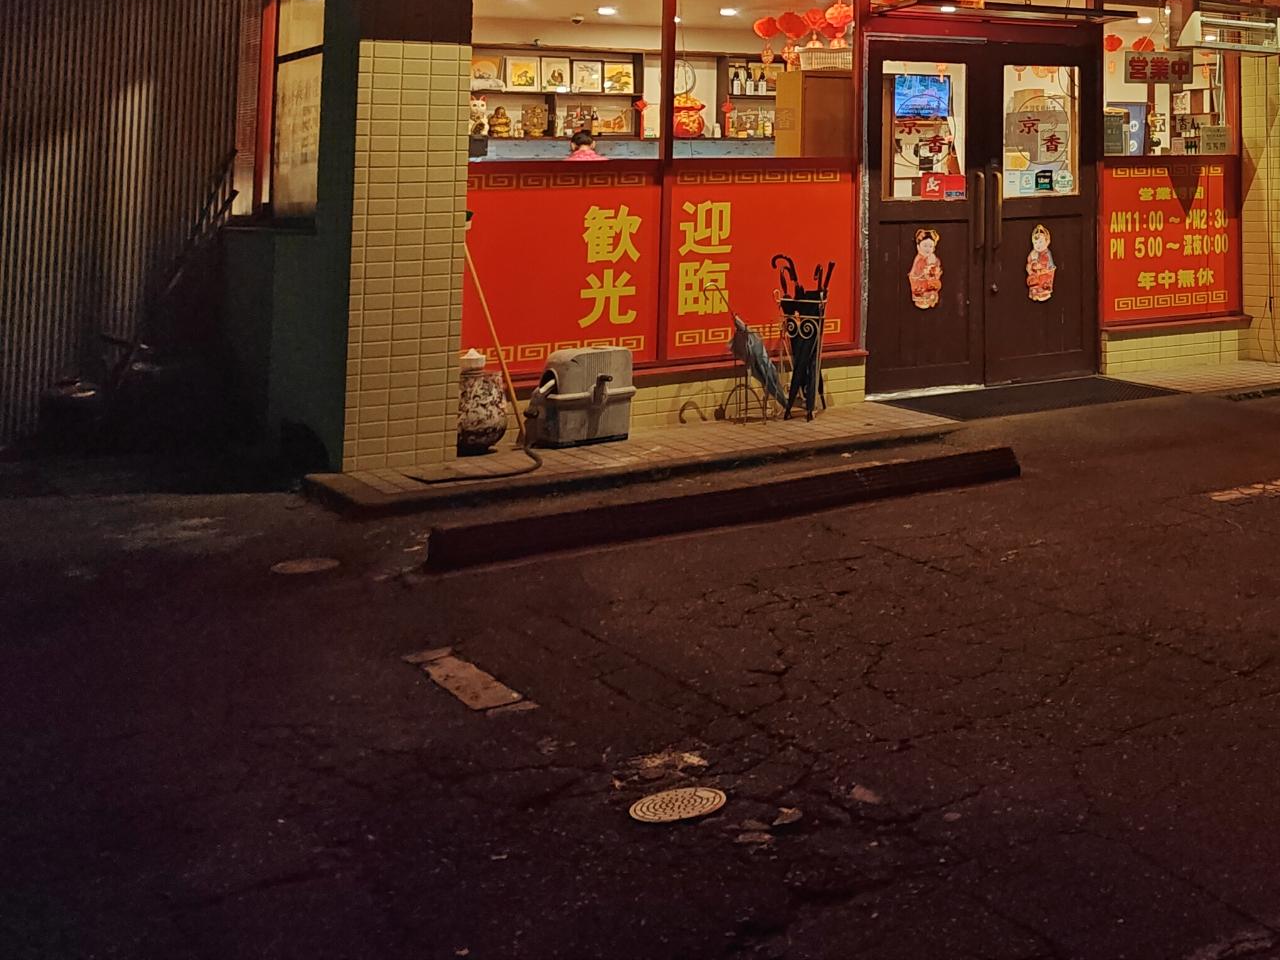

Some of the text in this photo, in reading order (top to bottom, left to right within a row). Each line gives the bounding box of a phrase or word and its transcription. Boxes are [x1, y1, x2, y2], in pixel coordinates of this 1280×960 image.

[1129, 56, 1189, 80] 営業中
[1138, 186, 1204, 201] 営業
[1137, 267, 1215, 290] 年中無休
